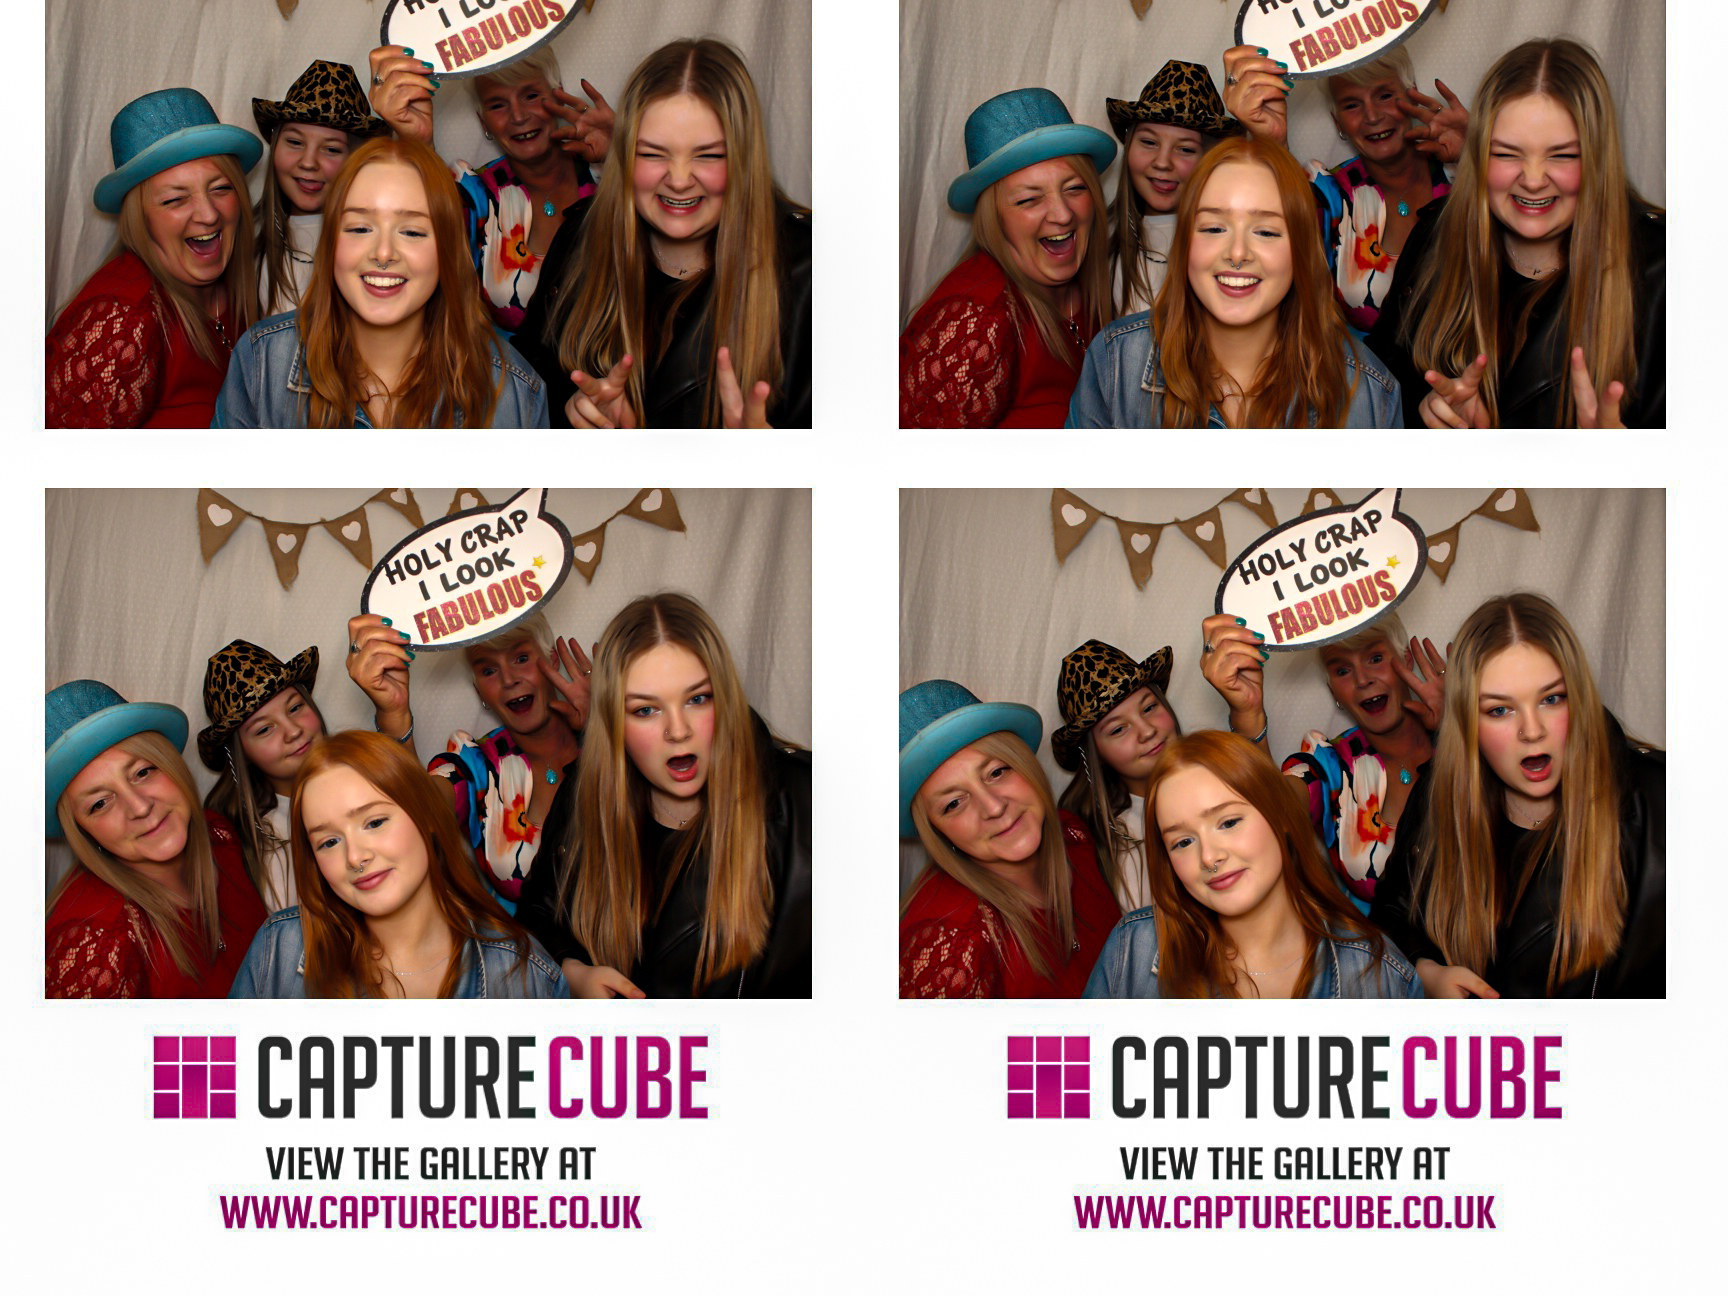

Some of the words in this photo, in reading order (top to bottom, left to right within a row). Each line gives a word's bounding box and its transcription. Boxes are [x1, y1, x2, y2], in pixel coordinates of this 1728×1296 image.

[438, 7, 451, 28] I
[1292, 7, 1305, 28] I
[385, 538, 453, 585] HOLY
[460, 509, 528, 554] CRAP
[418, 580, 431, 601] I
[440, 547, 515, 593] LOOK
[1239, 538, 1307, 585] HOLY
[1314, 509, 1382, 554] CRAP
[1272, 580, 1285, 601] I
[1294, 547, 1369, 593] LOOK
[413, 570, 543, 644] FABULOUS
[1267, 570, 1397, 644] FABULOUS
